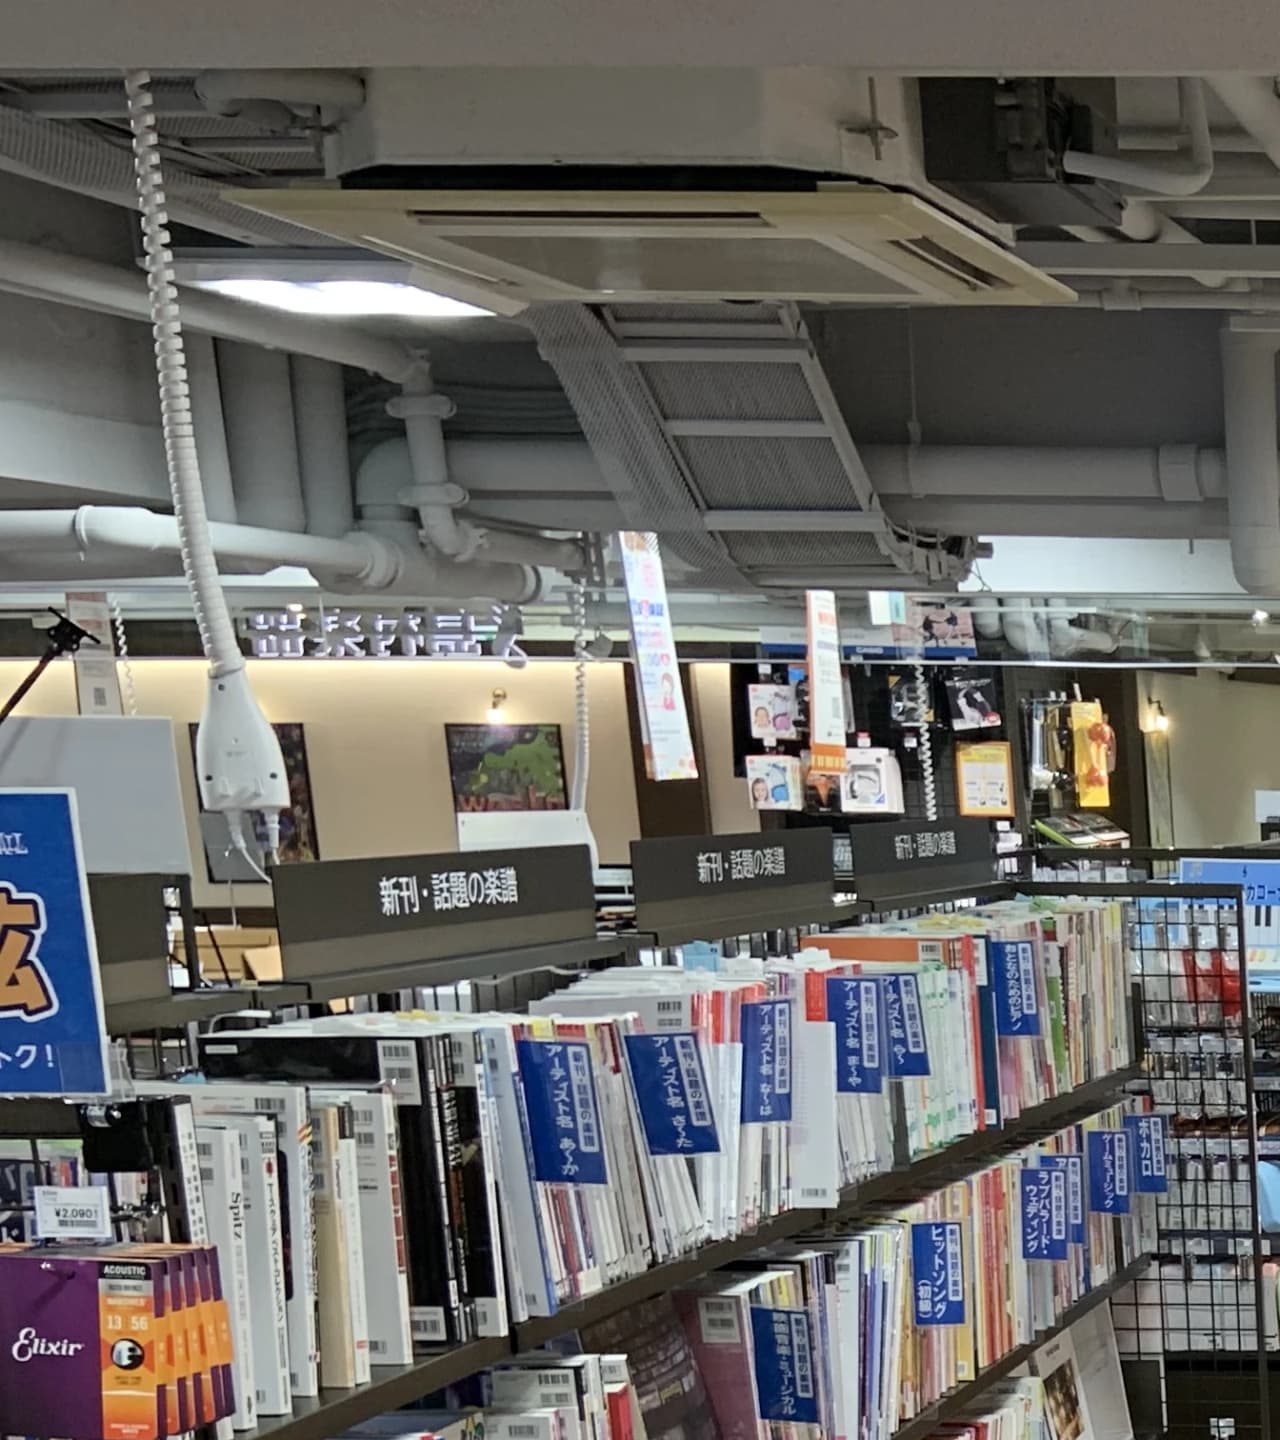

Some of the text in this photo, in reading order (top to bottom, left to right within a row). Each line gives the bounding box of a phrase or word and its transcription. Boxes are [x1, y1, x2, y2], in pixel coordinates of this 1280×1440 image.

[698, 846, 786, 882] 新刊・話題の楽譜
[379, 868, 519, 916] 新刊・話題の楽譜
[230, 1191, 243, 1241] Spitz
[103, 1265, 146, 1276] ACOUSTIC
[931, 1225, 947, 1319] ヒットソング
[107, 1315, 148, 1330] 13 56
[12, 1327, 83, 1362] Elixir
